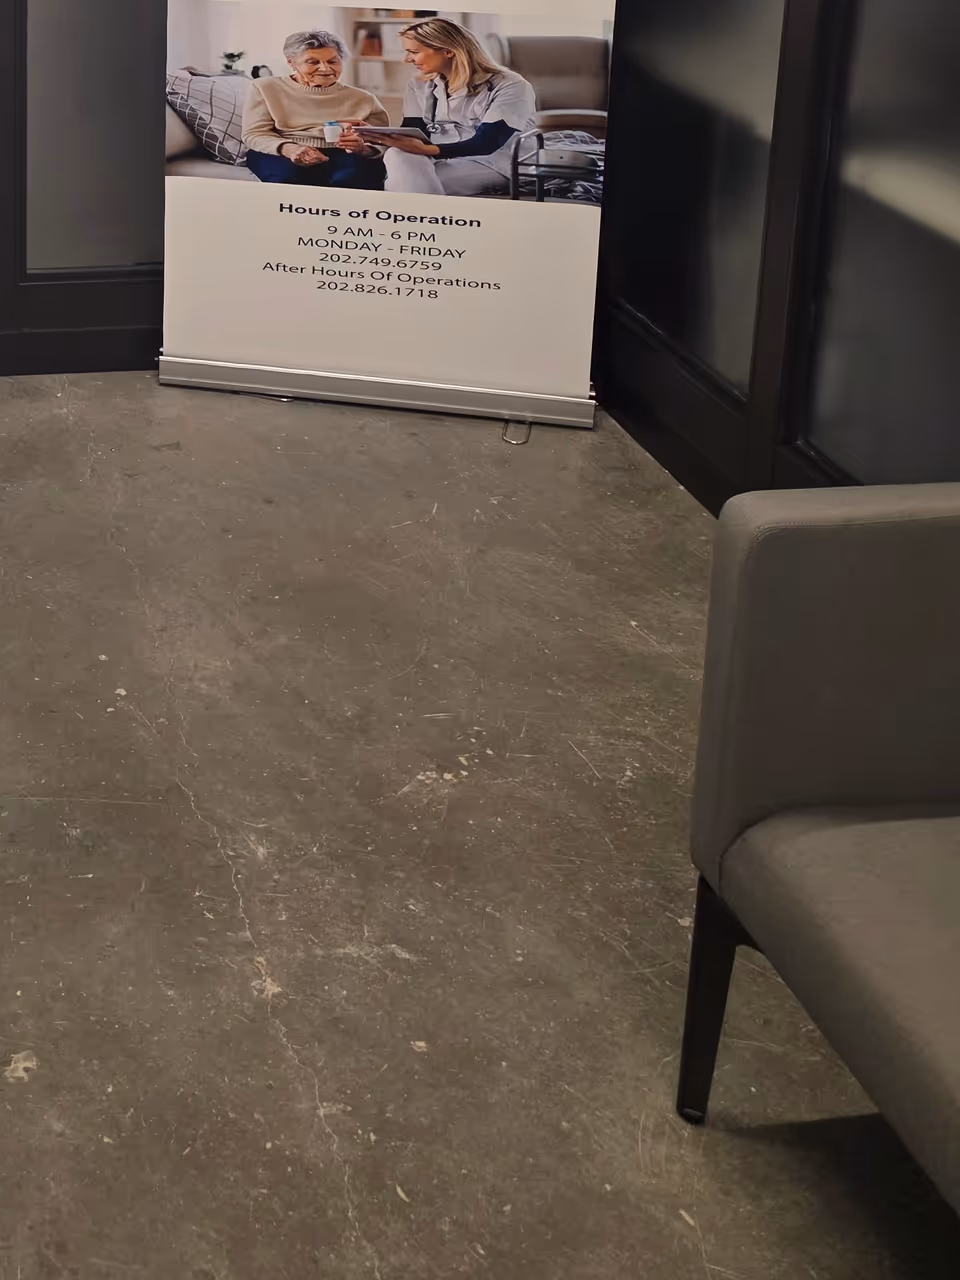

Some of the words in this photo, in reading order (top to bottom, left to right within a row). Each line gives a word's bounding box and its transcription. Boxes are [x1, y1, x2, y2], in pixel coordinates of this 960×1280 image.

[278, 202, 341, 217] Hours
[347, 208, 370, 219] of
[375, 210, 481, 228] Operation
[326, 225, 338, 235] 9
[342, 226, 373, 238] AM
[390, 230, 402, 240] 6
[407, 230, 436, 243] PM
[297, 236, 382, 252] MONDAY
[399, 244, 466, 259] FRIDAY
[318, 252, 442, 271] 202.749.6759
[262, 261, 307, 274] After
[311, 265, 365, 279] Hours
[369, 270, 393, 281] Of
[396, 272, 501, 290] Operations
[315, 279, 438, 299] 202.826.1718
